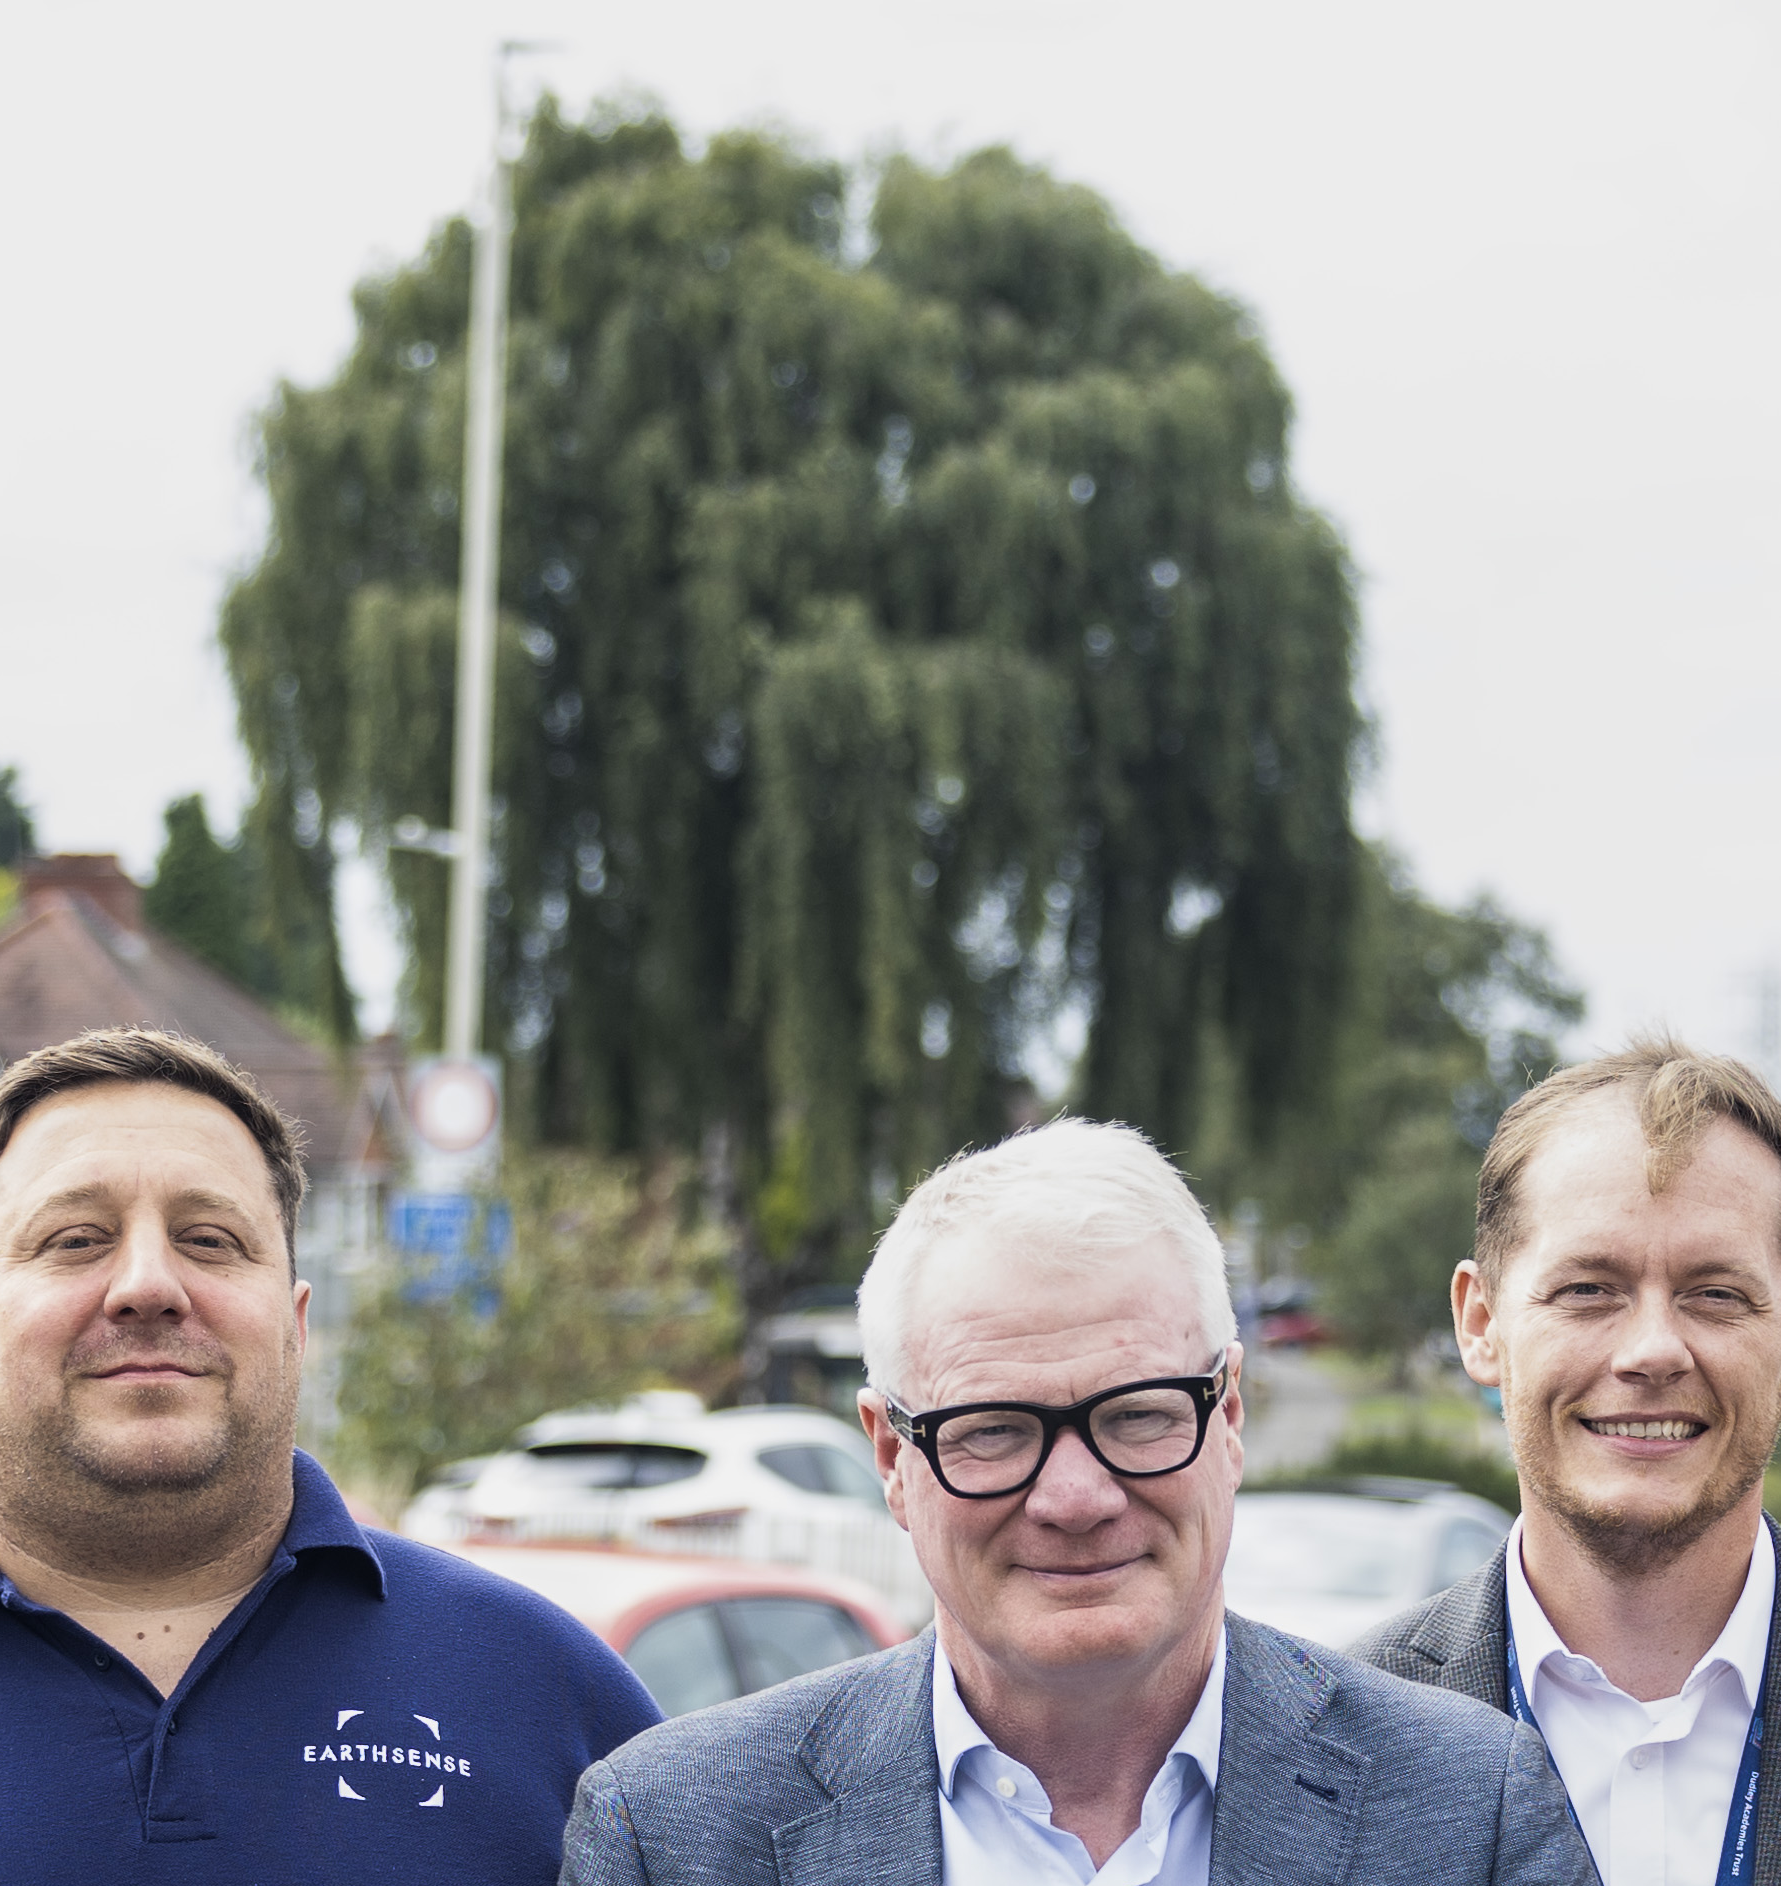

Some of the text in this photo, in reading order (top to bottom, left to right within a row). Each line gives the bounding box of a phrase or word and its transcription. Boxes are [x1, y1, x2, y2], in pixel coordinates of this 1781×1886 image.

[303, 1744, 472, 1778] EARTHSENSE
[1731, 1771, 1759, 1877] Dudley Academies Trust
